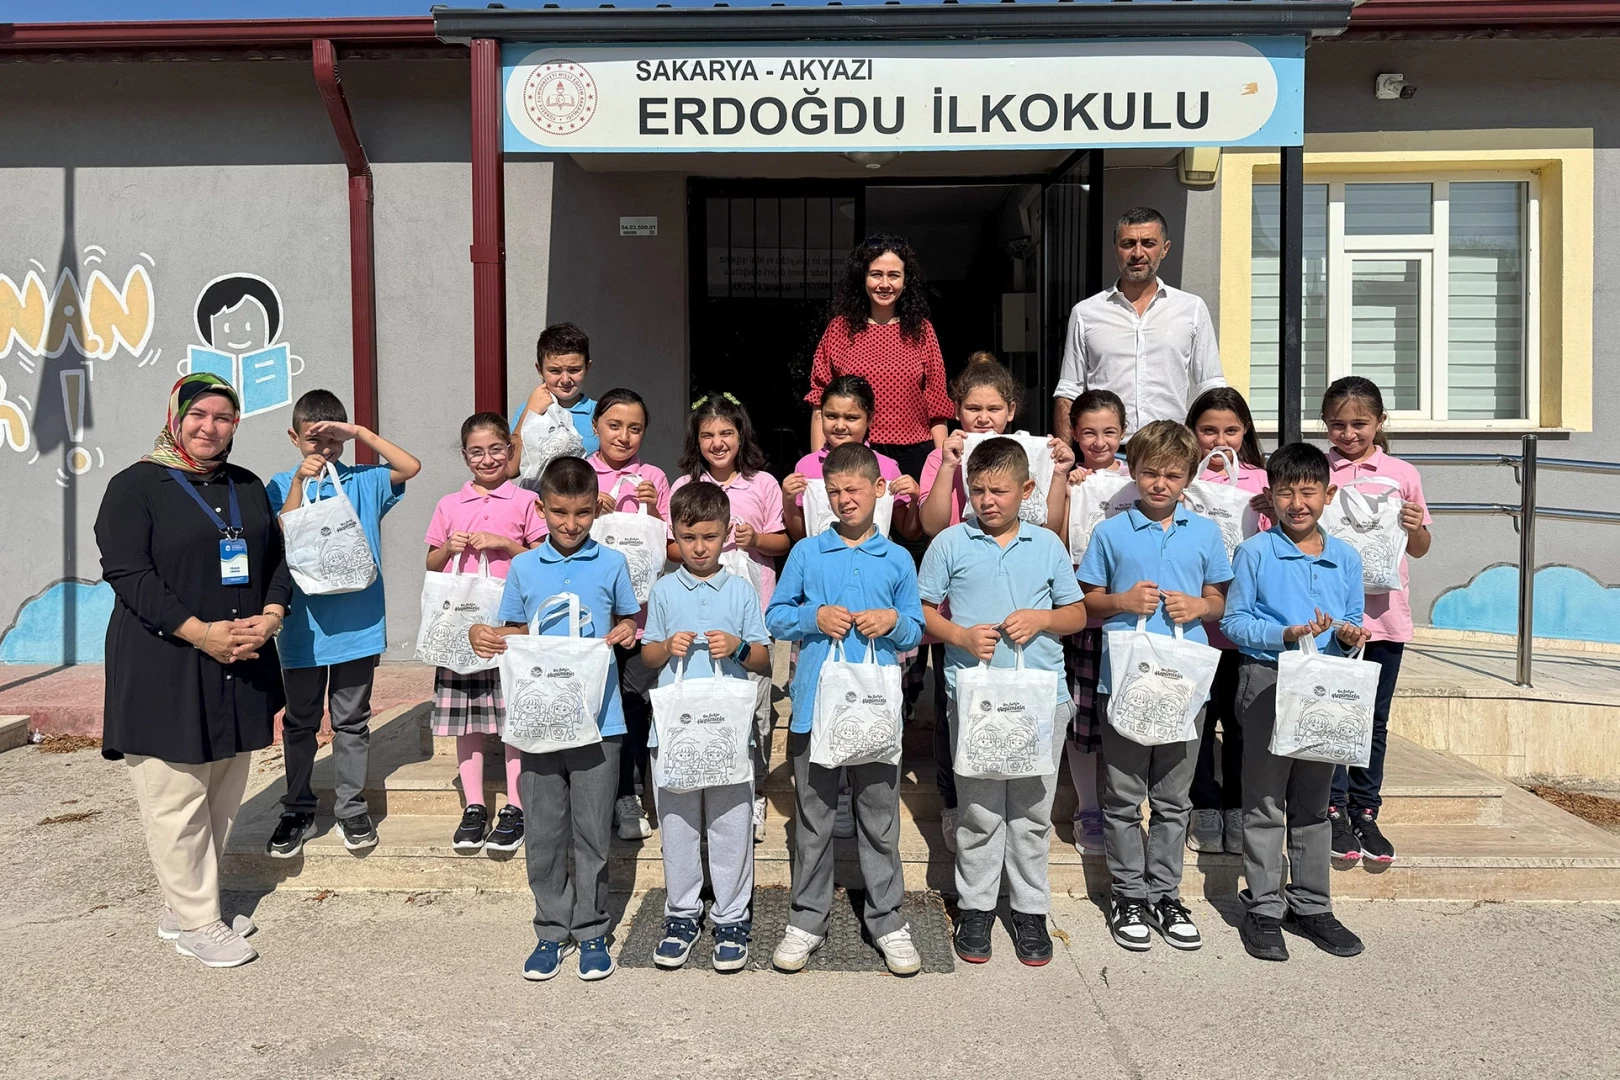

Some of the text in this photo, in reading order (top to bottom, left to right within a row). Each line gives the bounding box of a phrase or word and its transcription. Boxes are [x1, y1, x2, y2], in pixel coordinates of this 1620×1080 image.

[636, 60, 759, 82] SAKARYA
[779, 59, 872, 81] AKYAZI
[639, 86, 1209, 136] ERDOĞDU İLKOKULU
